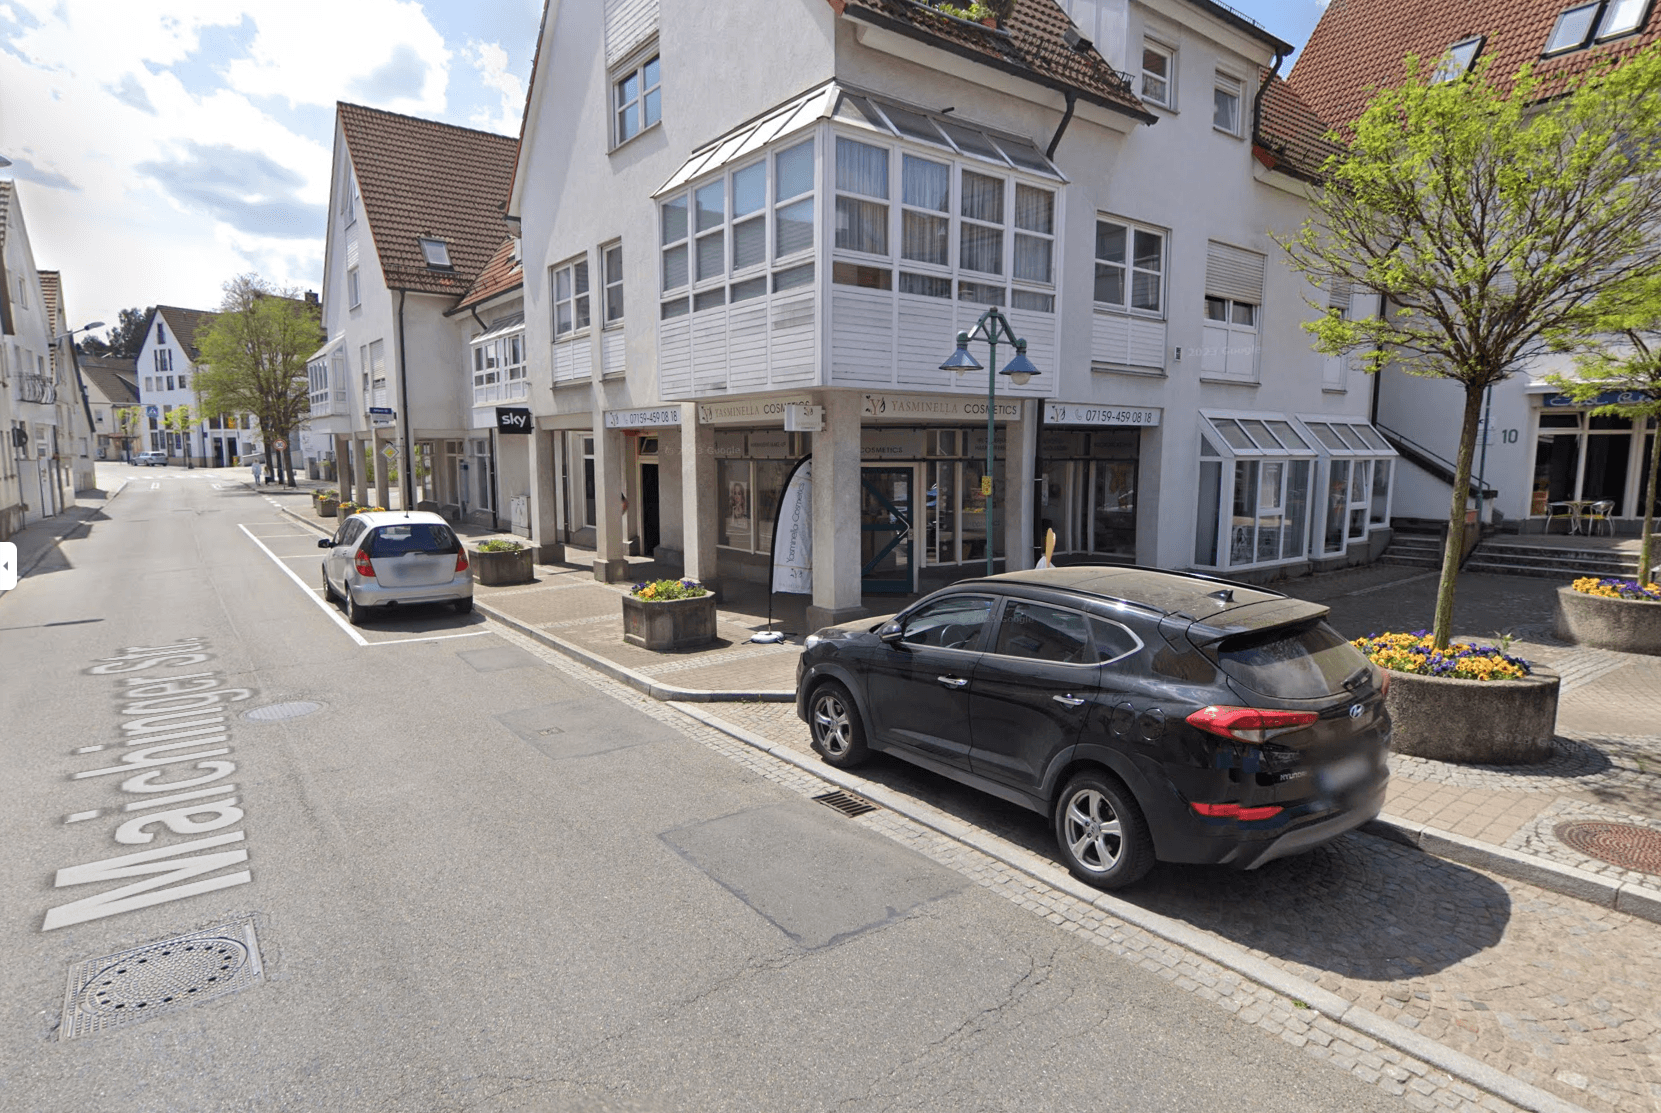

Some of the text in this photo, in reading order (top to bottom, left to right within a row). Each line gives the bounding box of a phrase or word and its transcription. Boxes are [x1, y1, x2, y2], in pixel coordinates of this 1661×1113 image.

[715, 405, 760, 418] YASMINELLA
[891, 400, 958, 413] YASMINELLA
[501, 412, 527, 428] sky
[629, 410, 678, 424] 07159-459 08 18
[1085, 409, 1131, 422] 07159-459
[1132, 411, 1142, 423] 08
[1144, 412, 1152, 423] 18
[1502, 428, 1518, 444] 10
[786, 481, 805, 564] Yasminella Cosmetics
